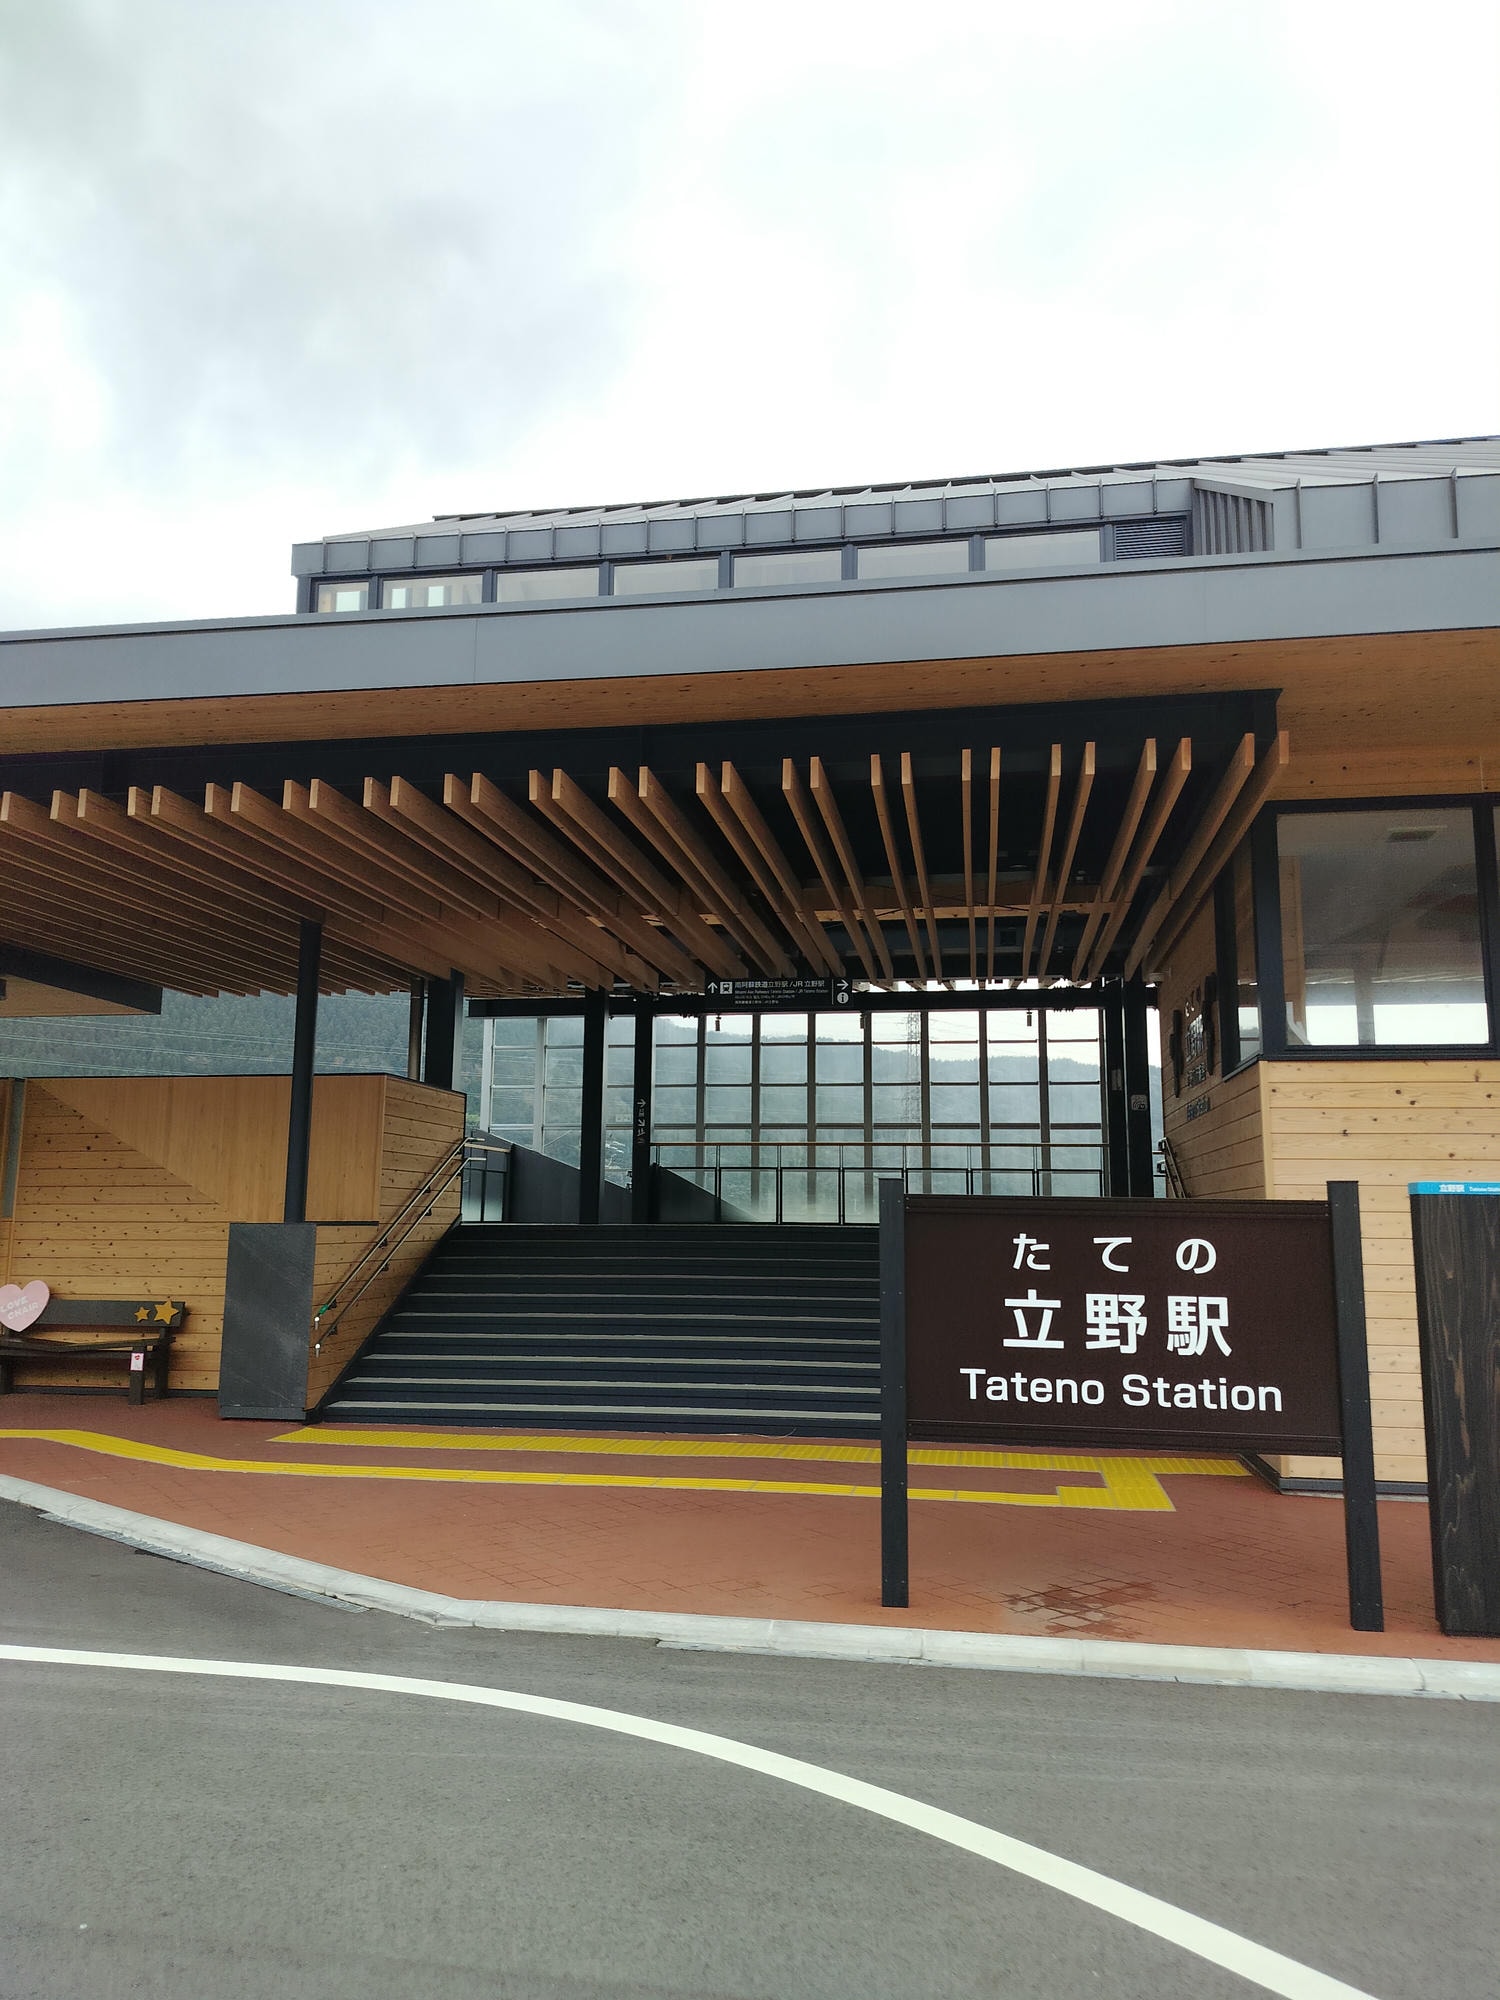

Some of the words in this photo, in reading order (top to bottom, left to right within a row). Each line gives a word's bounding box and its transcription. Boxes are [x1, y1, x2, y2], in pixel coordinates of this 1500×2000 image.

[1013, 1233, 1217, 1274] たての
[0, 1296, 28, 1313] LOVE
[8, 1302, 39, 1320] CHAIR
[1003, 1289, 1232, 1357] 立野駅
[960, 1368, 1104, 1406] Tateno
[1122, 1374, 1283, 1413] Station
